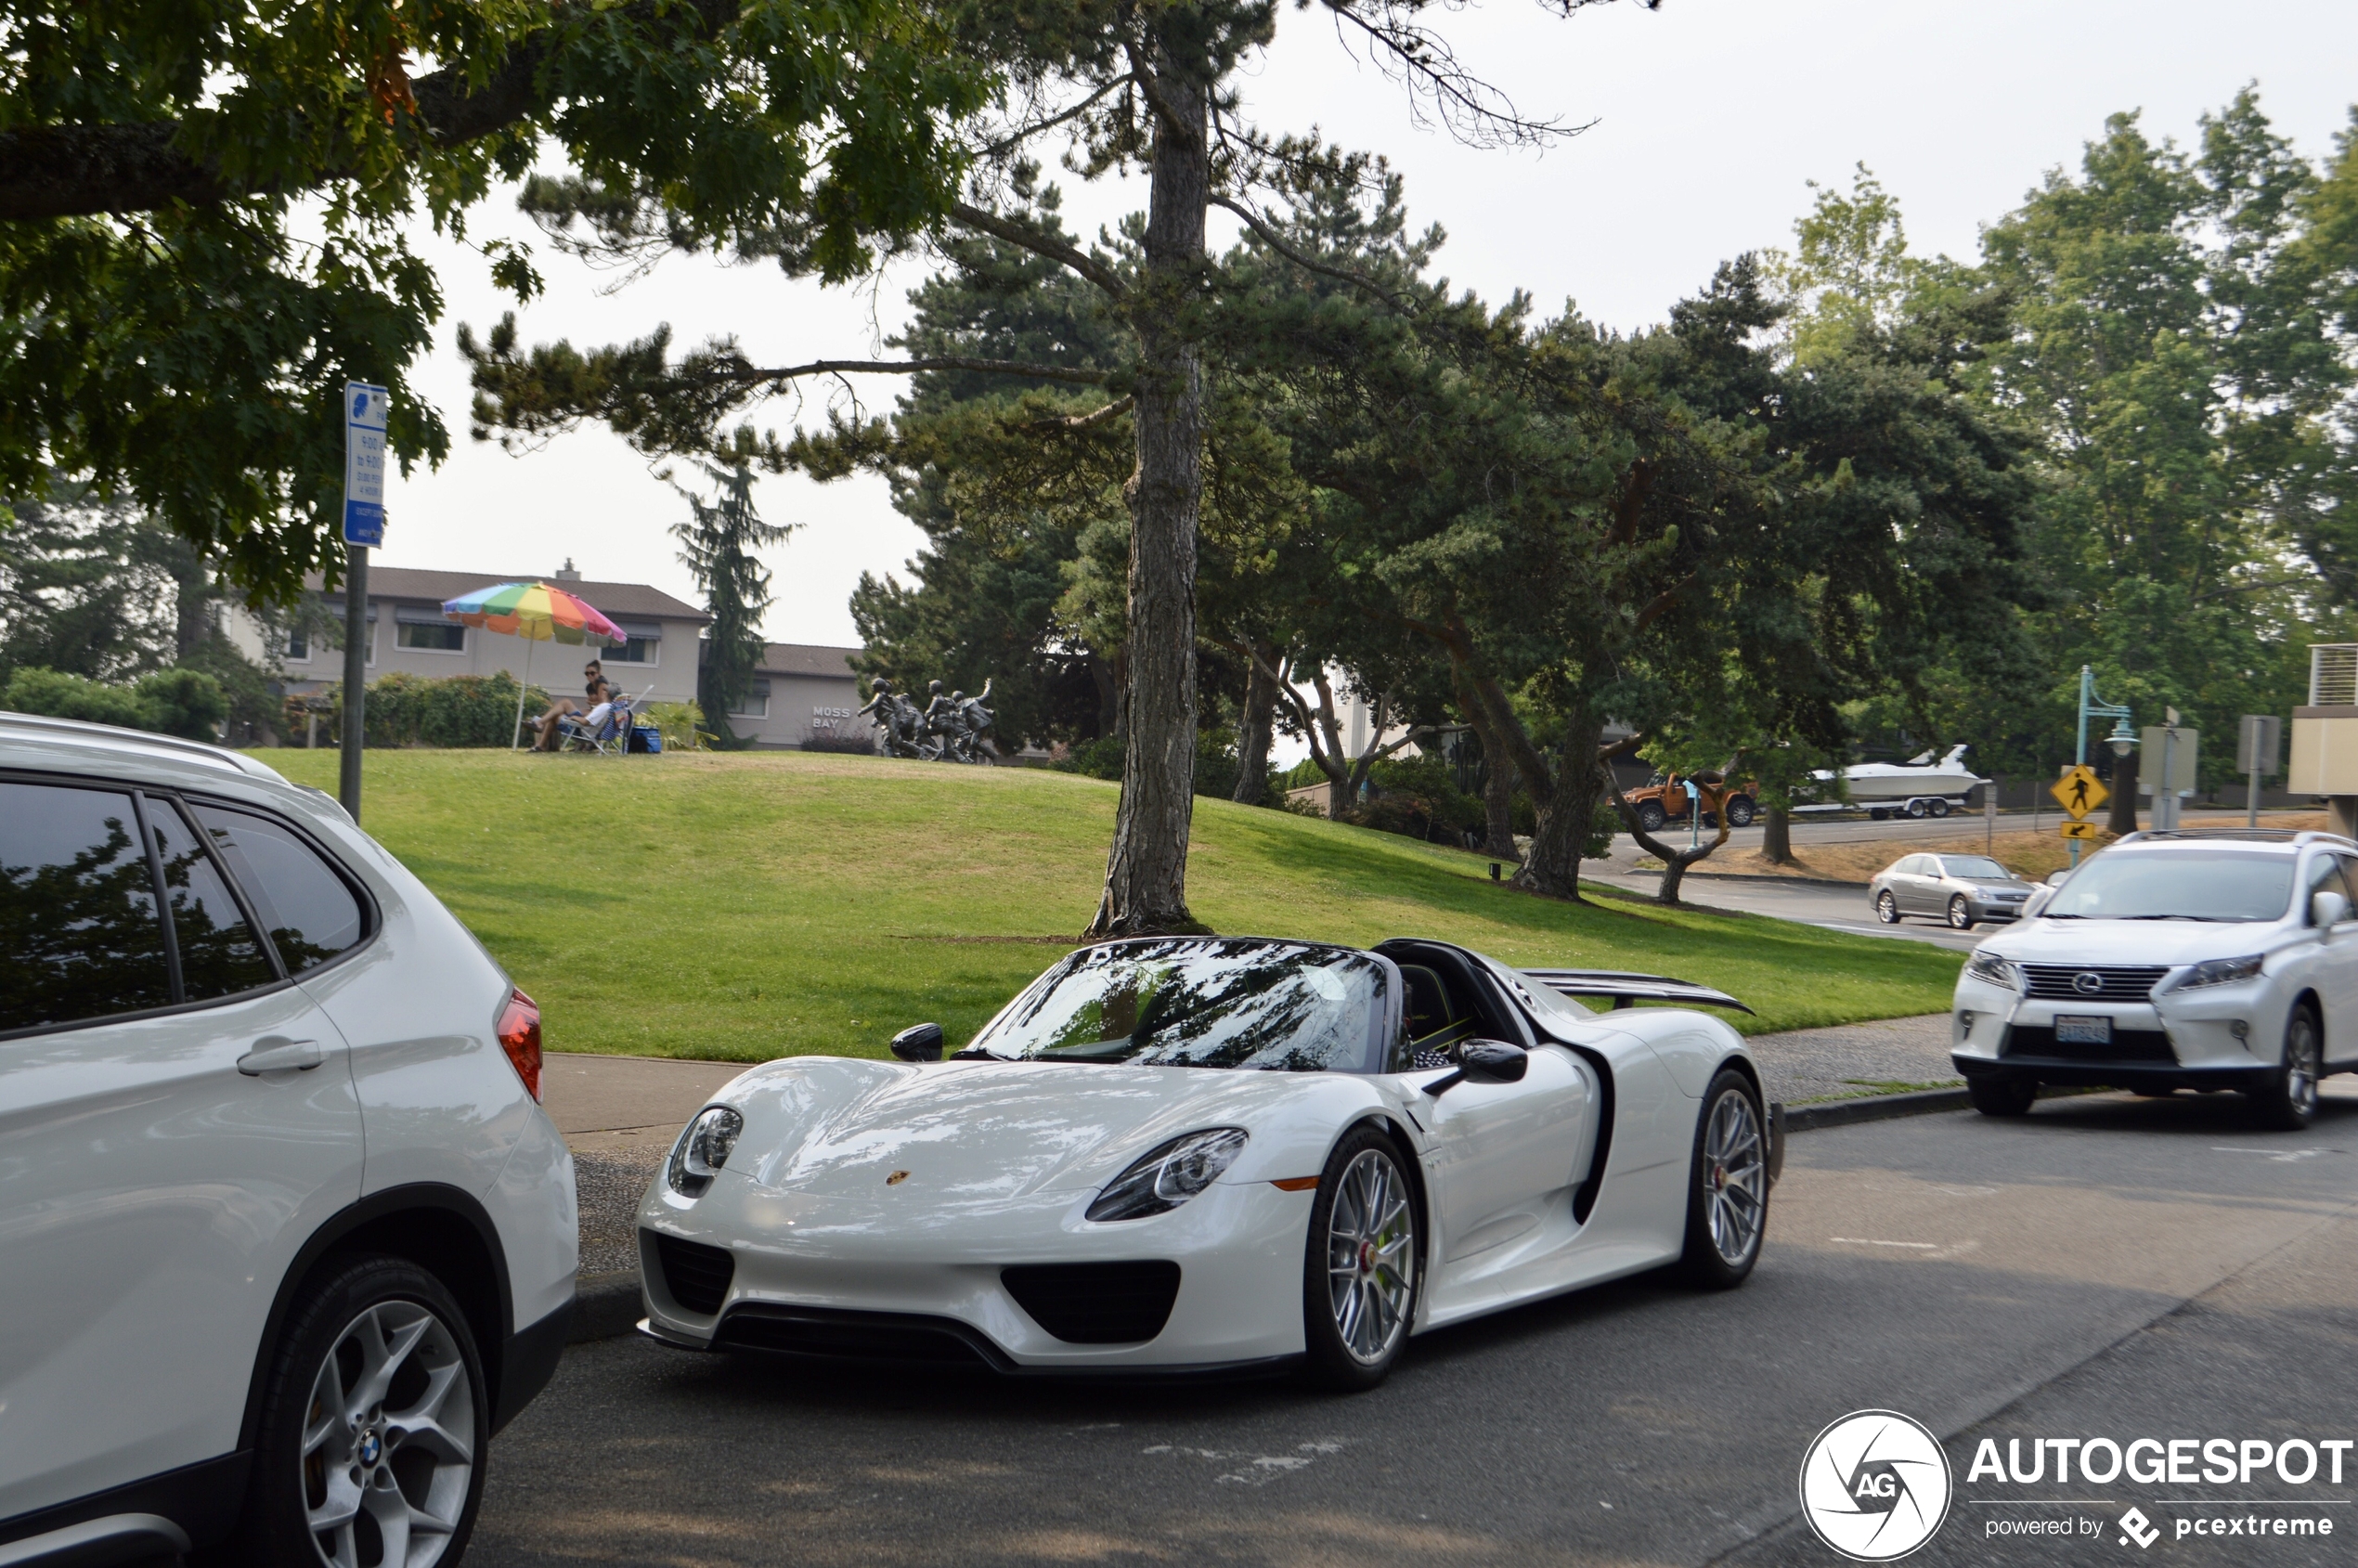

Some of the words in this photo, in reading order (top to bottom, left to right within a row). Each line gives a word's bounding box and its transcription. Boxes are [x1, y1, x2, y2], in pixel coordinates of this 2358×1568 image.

[362, 435, 378, 450] 9:00
[357, 455, 365, 466] to
[367, 455, 382, 470] 9:00
[813, 706, 850, 718] MOSS
[813, 718, 838, 729] BAY
